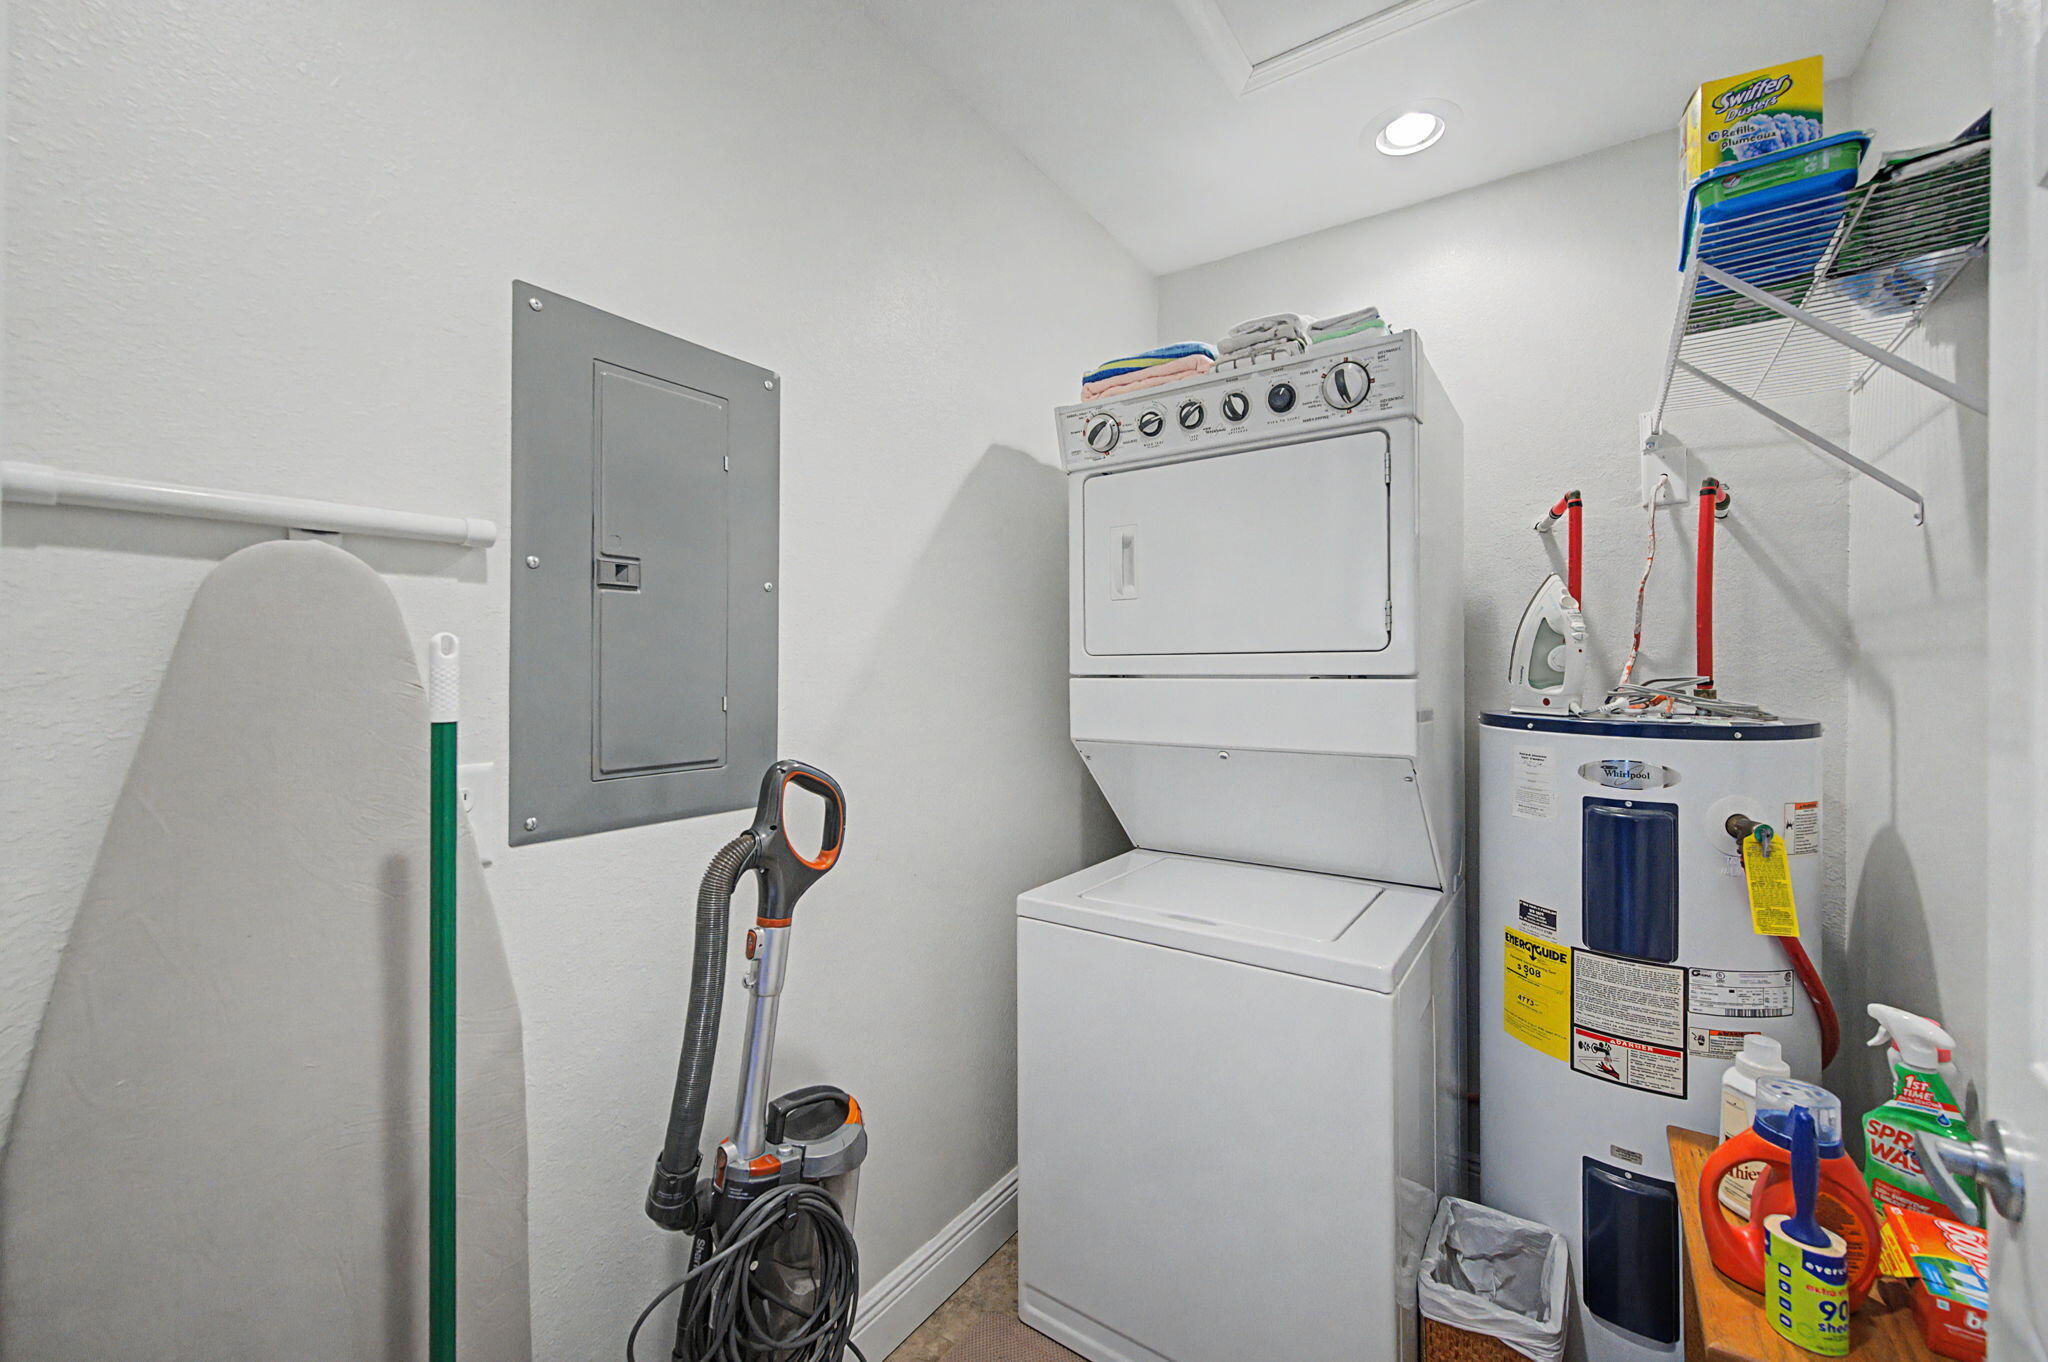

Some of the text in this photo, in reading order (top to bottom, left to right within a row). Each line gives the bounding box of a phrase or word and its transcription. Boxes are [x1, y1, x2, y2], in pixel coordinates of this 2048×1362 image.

[1715, 75, 1790, 115] Swiffer
[1724, 95, 1778, 123] Dusters
[1721, 125, 1757, 138] Refills
[1604, 768, 1650, 780] Whirlpool
[1903, 1088, 1934, 1101] TIME
[1866, 1119, 1915, 1151] SPR
[692, 1238, 706, 1270] Shar
